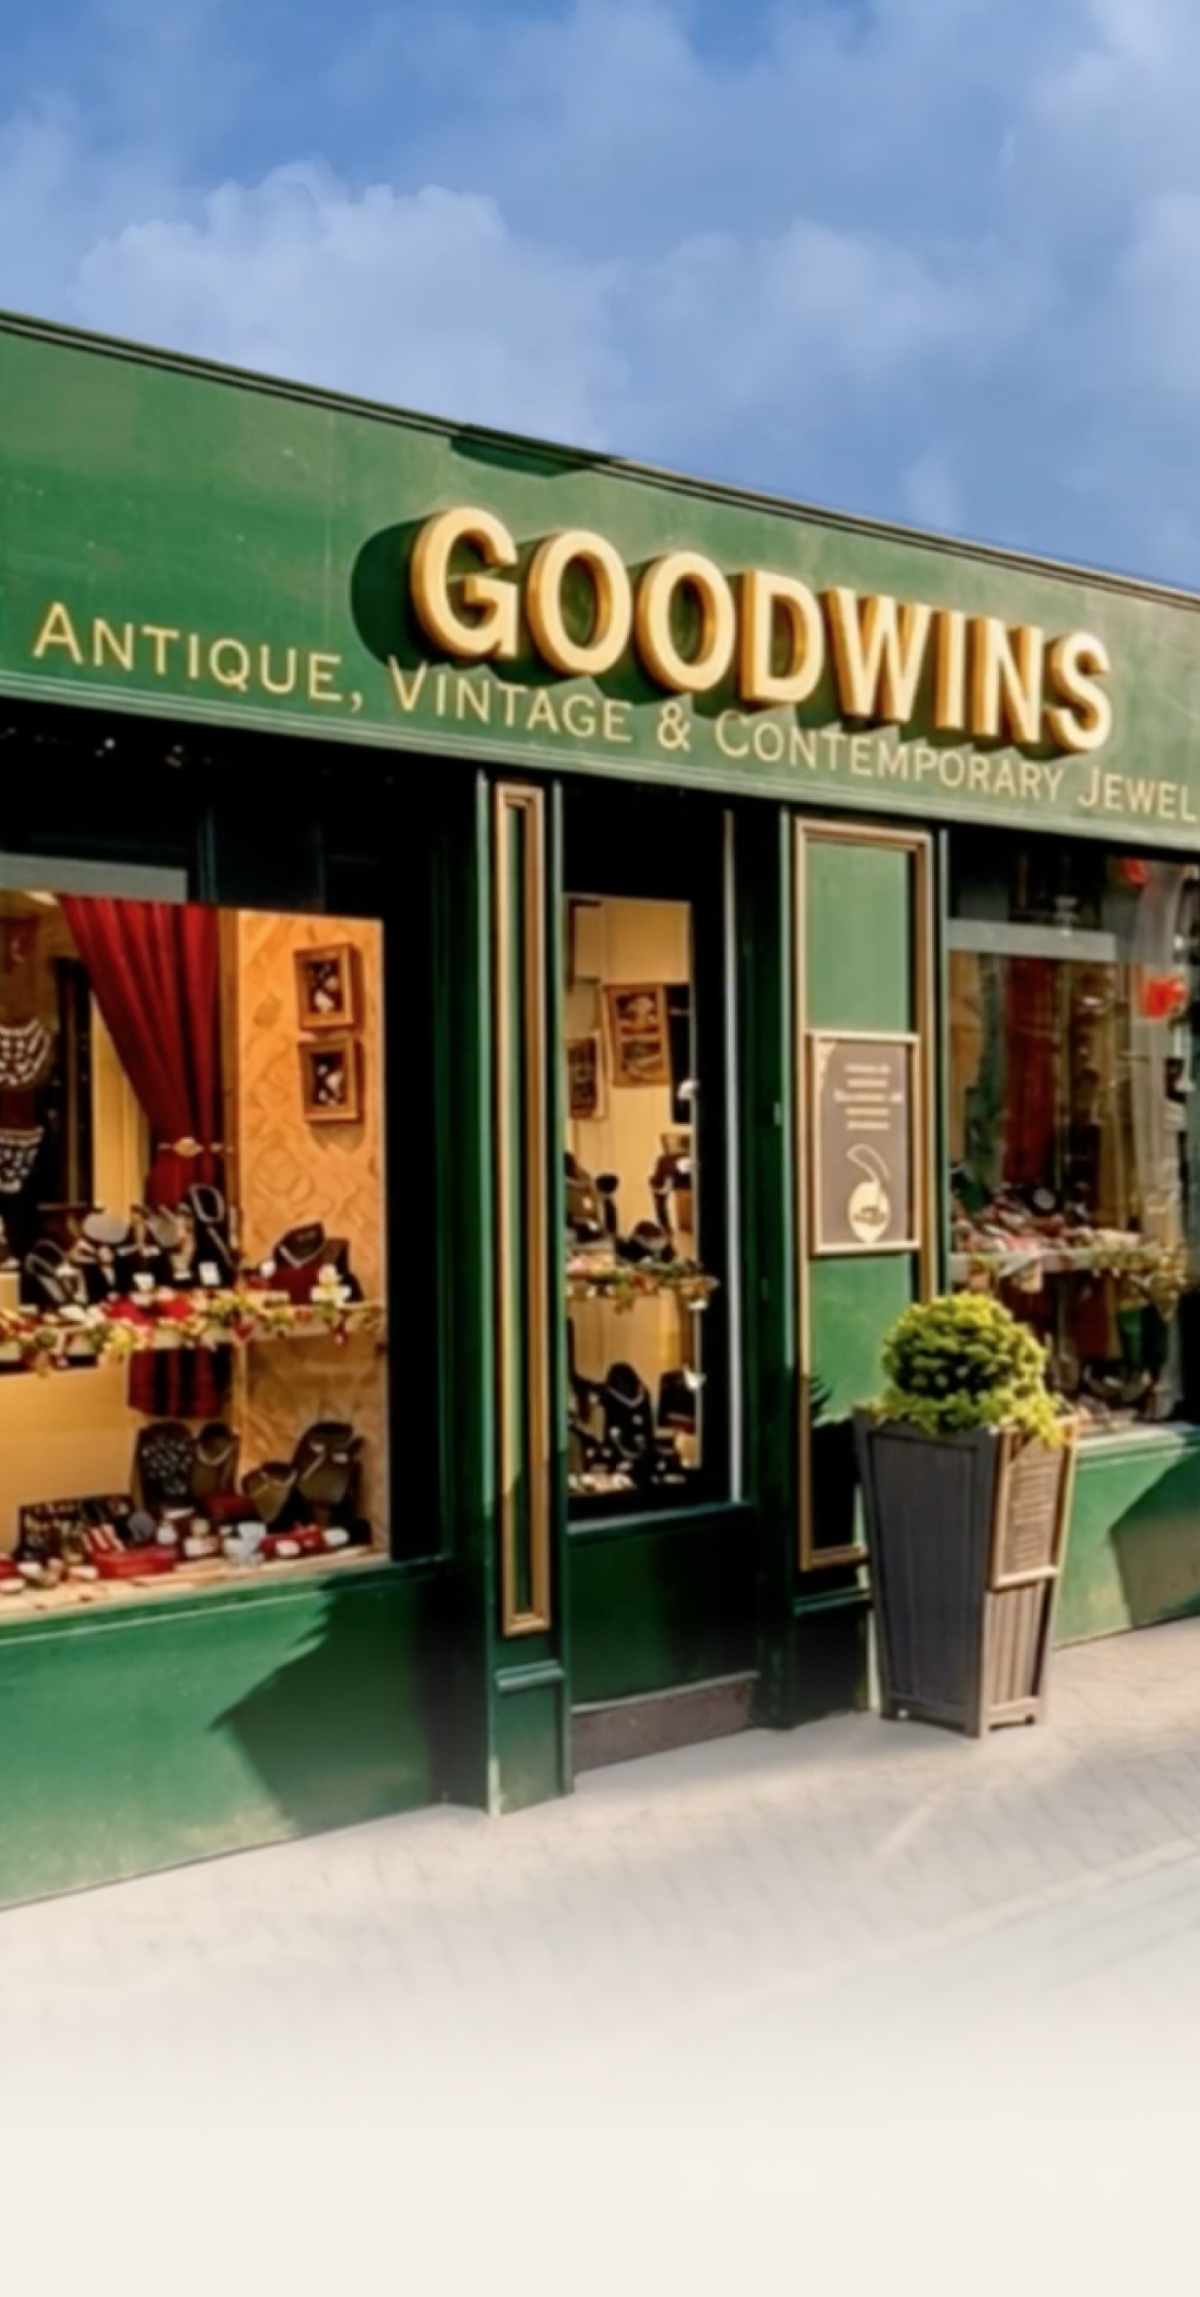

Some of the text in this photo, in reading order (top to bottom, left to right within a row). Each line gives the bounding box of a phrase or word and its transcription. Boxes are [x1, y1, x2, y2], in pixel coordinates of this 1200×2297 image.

[32, 602, 1198, 823] ANTIQUE, VINTAGE & CONTEMPORARY JEWEL
[411, 506, 1113, 753] GOODWINS
